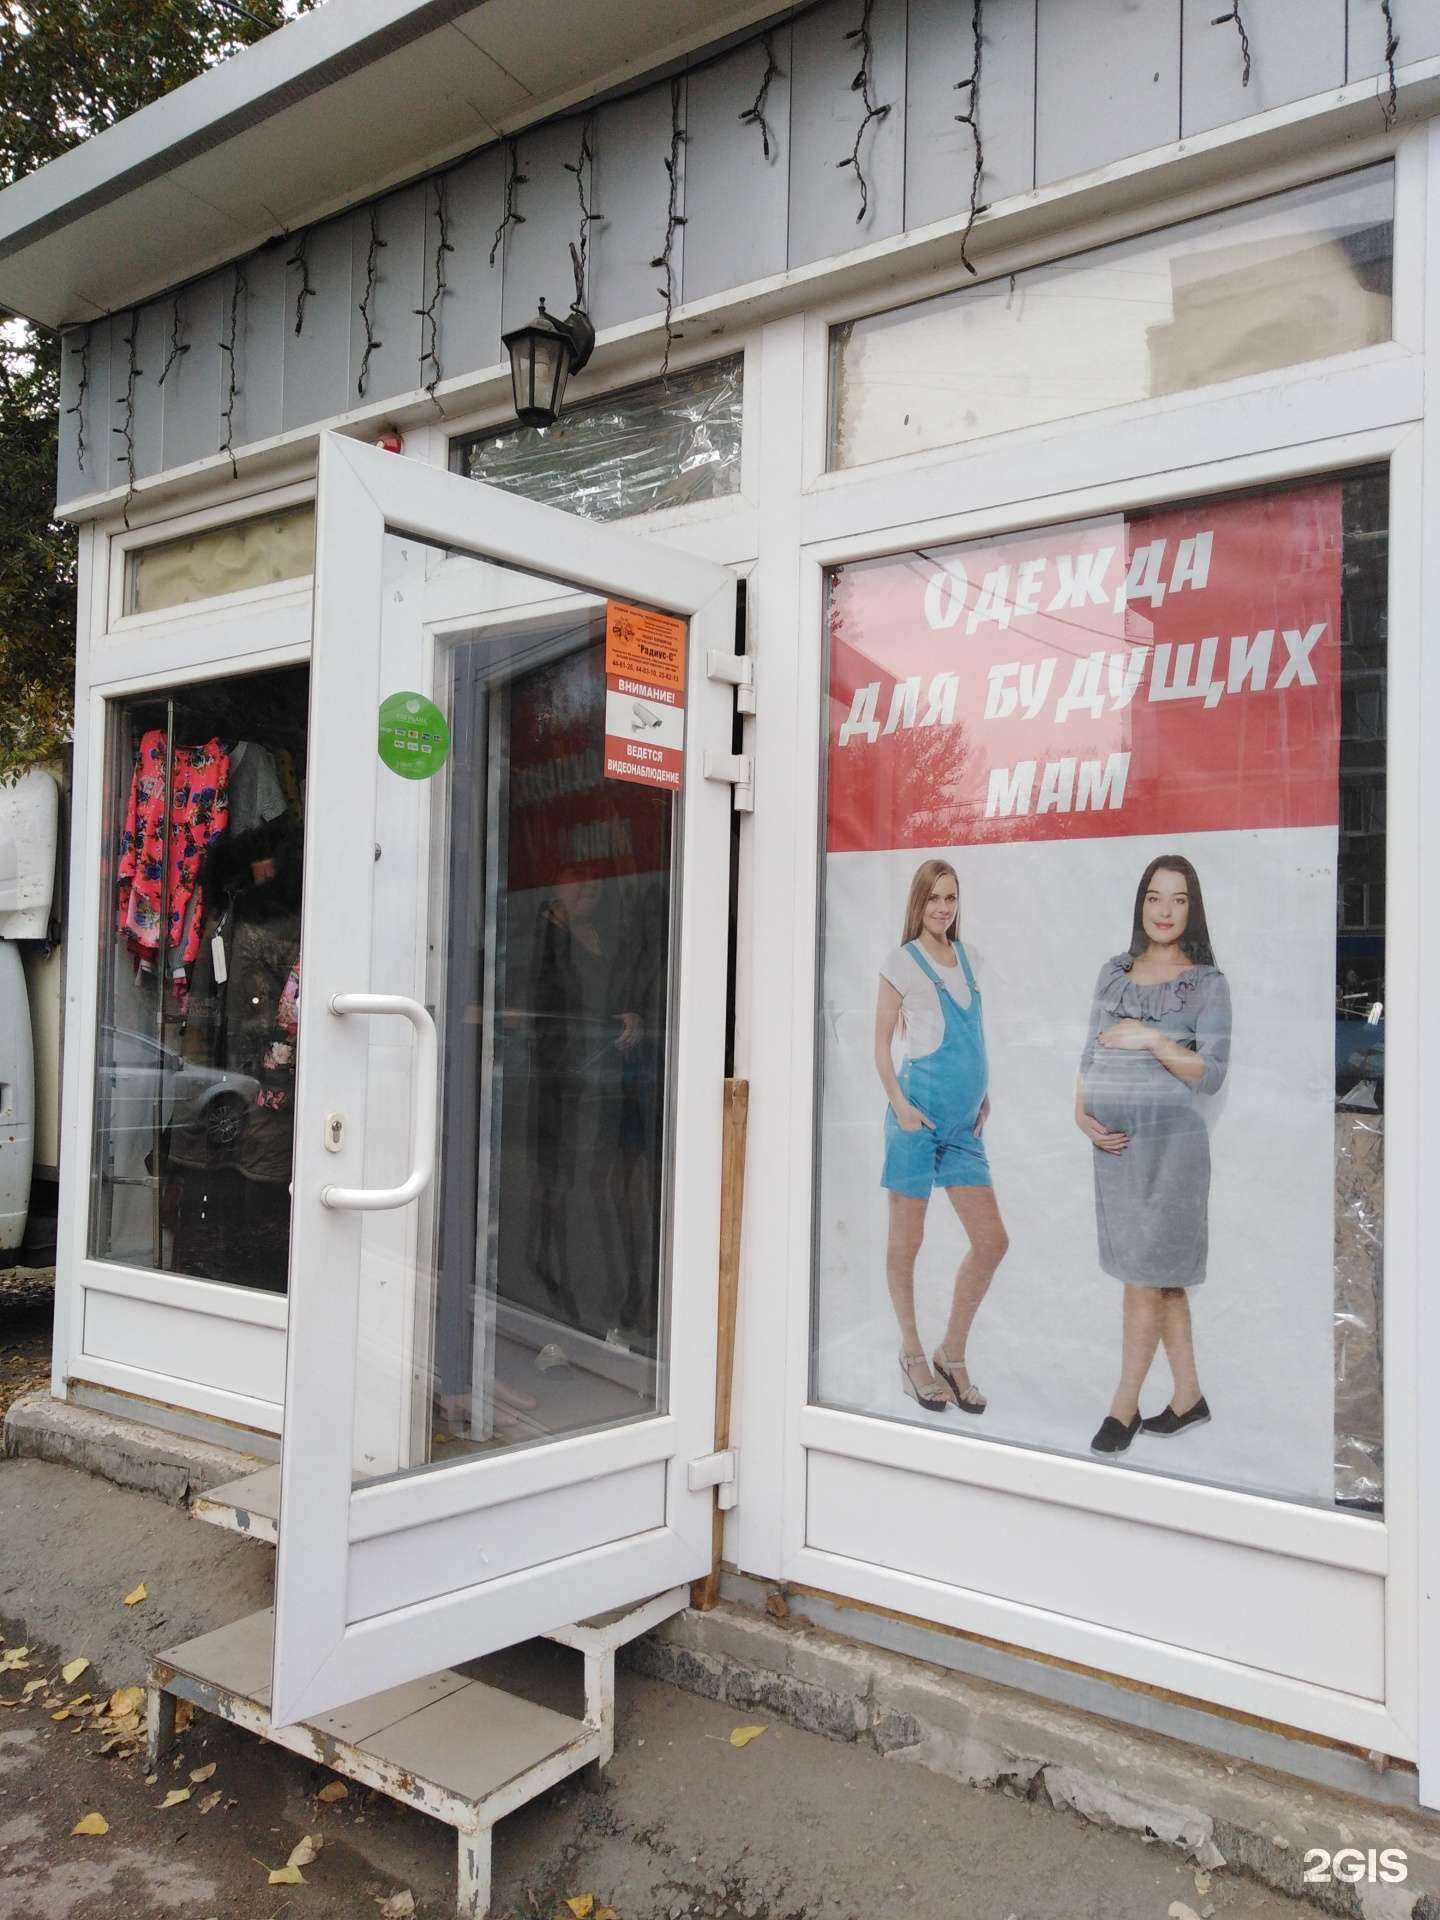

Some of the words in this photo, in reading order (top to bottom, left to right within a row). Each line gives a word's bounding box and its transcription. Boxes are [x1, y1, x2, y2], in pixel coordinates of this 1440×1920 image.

[923, 531, 1214, 635] ОДЕЖДА
[618, 678, 676, 704] ВНИМАНИЕ!
[838, 670, 959, 746] ДЛЯ
[984, 623, 1327, 724] БУДУЩИХ
[607, 758, 681, 784] ВИДЕОНАБЛЮДЕНИЕ
[626, 744, 664, 763] ВЕДЕТСЯ
[985, 752, 1131, 818] МАМ
